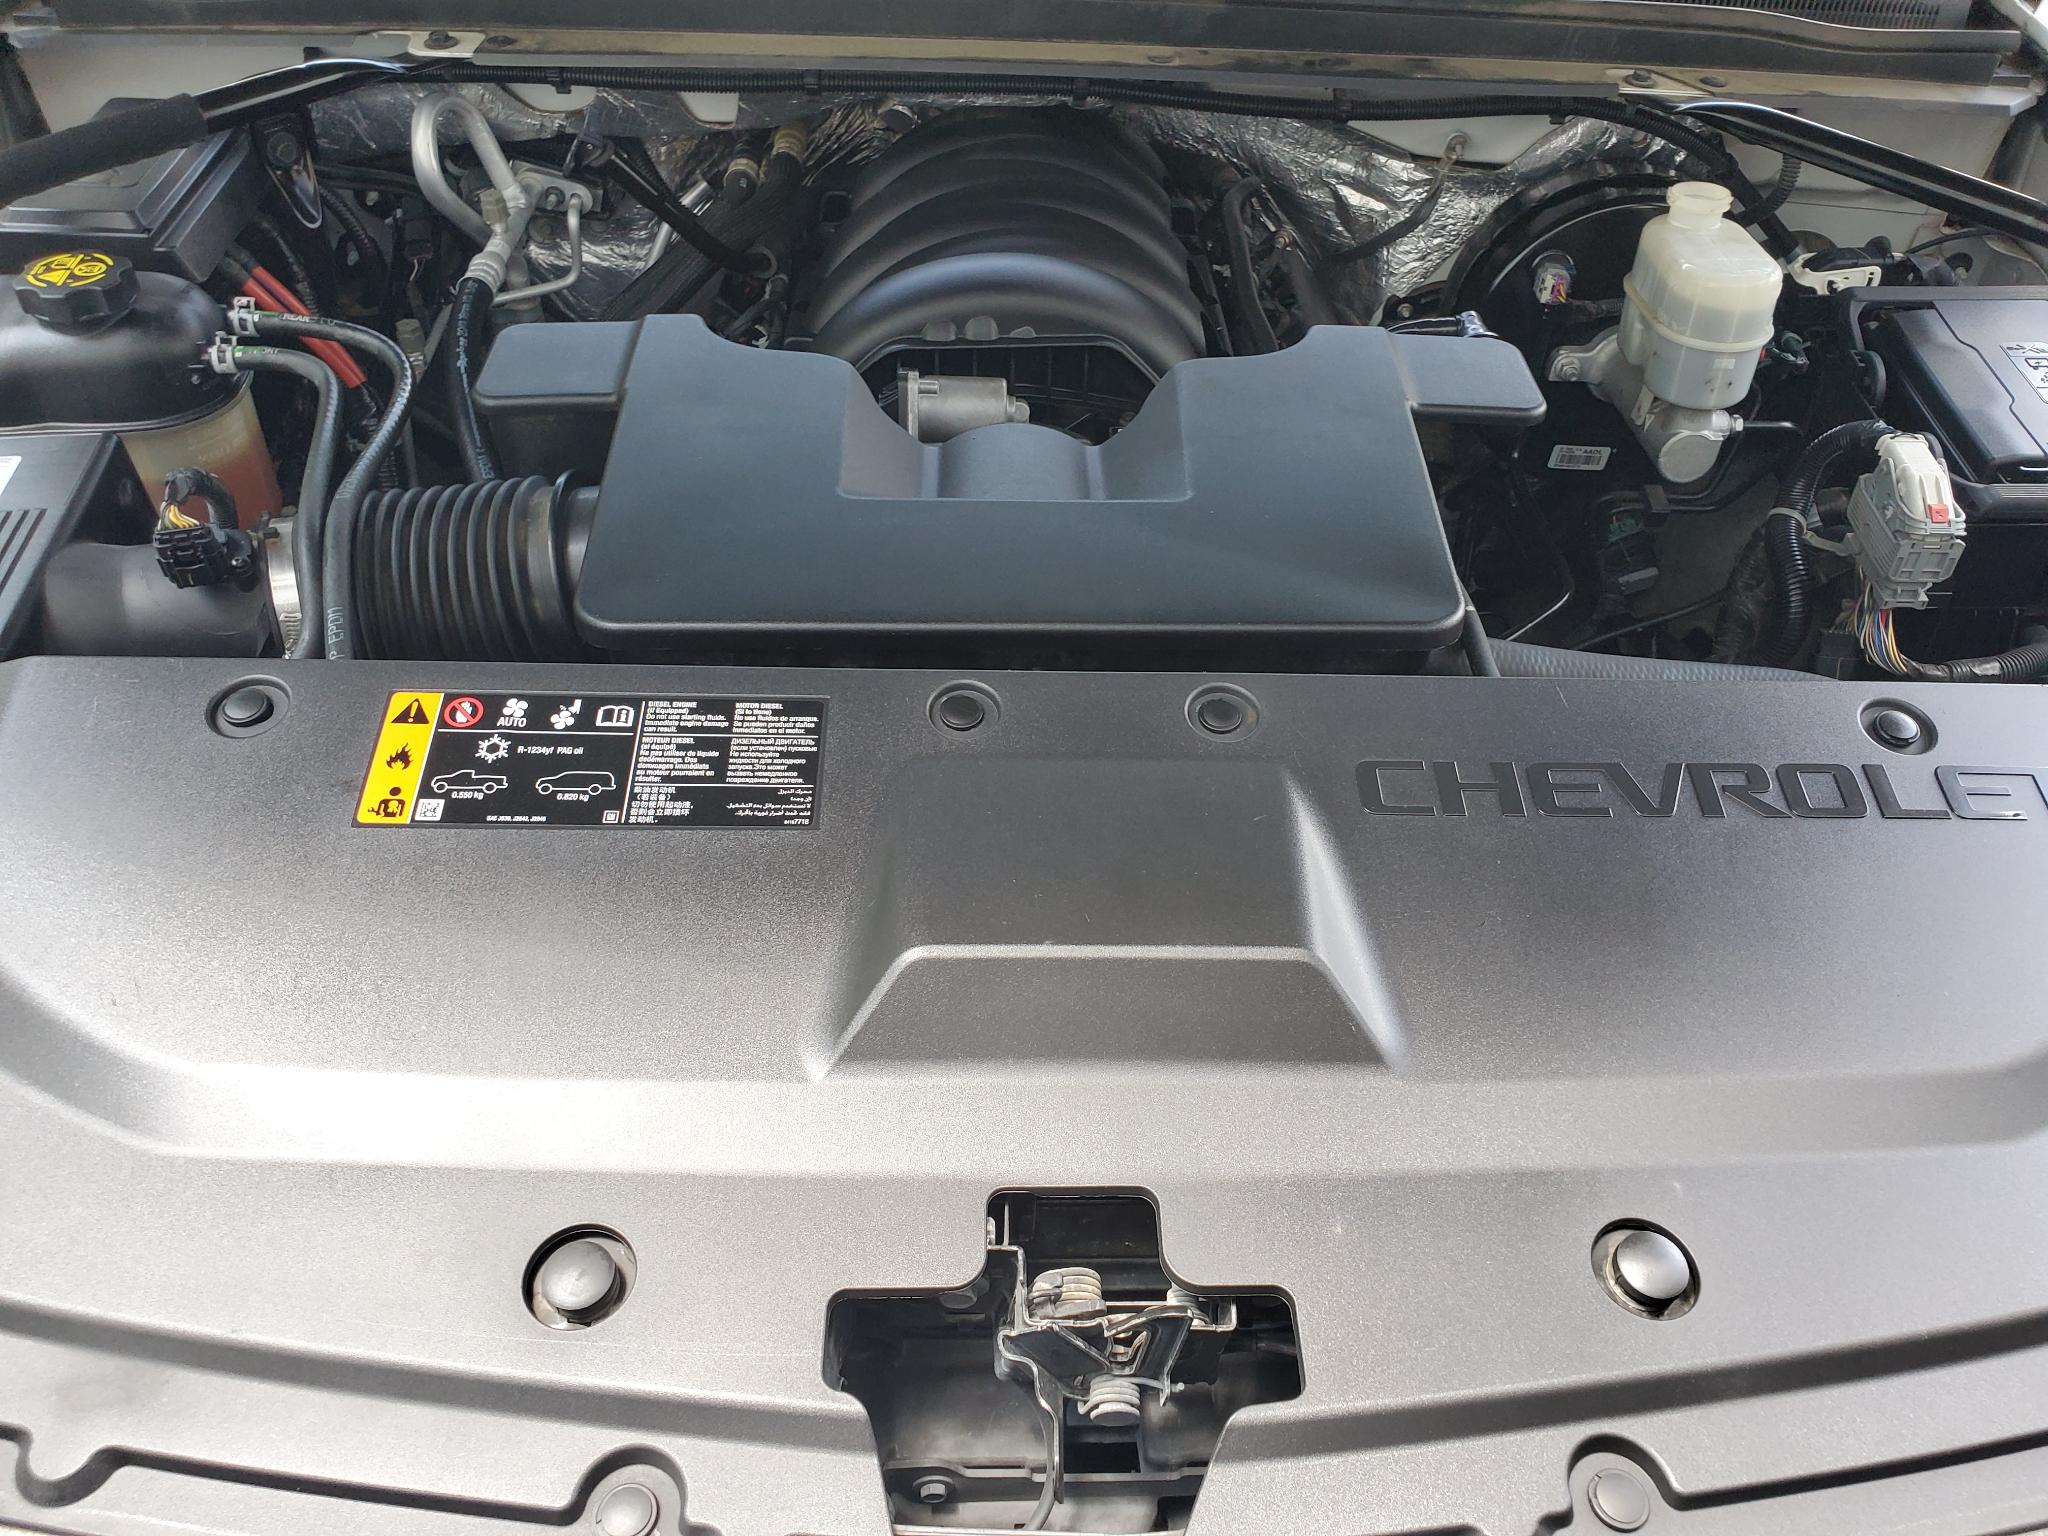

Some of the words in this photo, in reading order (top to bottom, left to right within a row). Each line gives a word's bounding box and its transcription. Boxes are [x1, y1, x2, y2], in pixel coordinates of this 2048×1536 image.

[656, 707, 689, 715] Equipped)
[497, 717, 527, 728] AUTO
[703, 720, 729, 728] damage
[641, 736, 671, 744] MOTEUR
[517, 745, 554, 756] R-1234yf
[556, 746, 573, 755] PAG
[573, 747, 584, 755] oil
[1355, 760, 2048, 820] CHEVROLE
[451, 791, 473, 799] 0.550
[473, 791, 484, 800] kg
[556, 793, 579, 801] 0.820
[578, 793, 590, 802] kg
